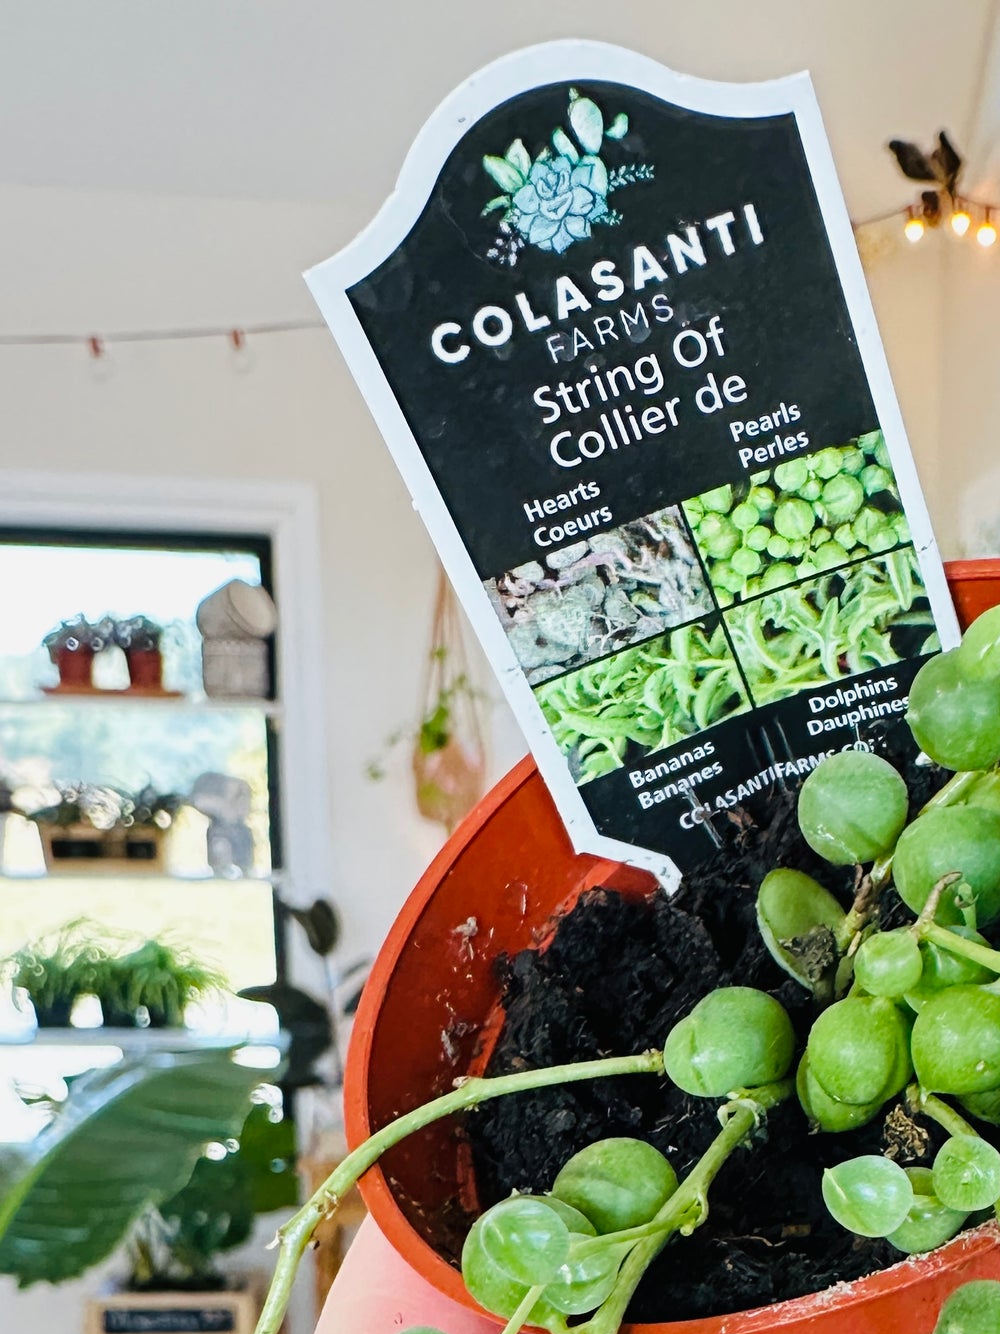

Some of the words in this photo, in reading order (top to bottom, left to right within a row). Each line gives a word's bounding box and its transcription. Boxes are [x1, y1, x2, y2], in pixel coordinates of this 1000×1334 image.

[431, 203, 765, 364] COLASANTI
[546, 294, 674, 364] FARMS
[532, 353, 664, 424] String
[672, 315, 726, 368] Of
[549, 396, 681, 468] Collier
[695, 372, 748, 414] de
[729, 402, 801, 442] Pearls
[738, 431, 809, 468] Perles
[523, 480, 601, 523] Hearts
[533, 504, 613, 547] Coeurs
[806, 696, 909, 736] Dauphines
[808, 675, 898, 714] Dolphins
[628, 741, 715, 789] Bananas
[637, 760, 724, 810] Bananes
